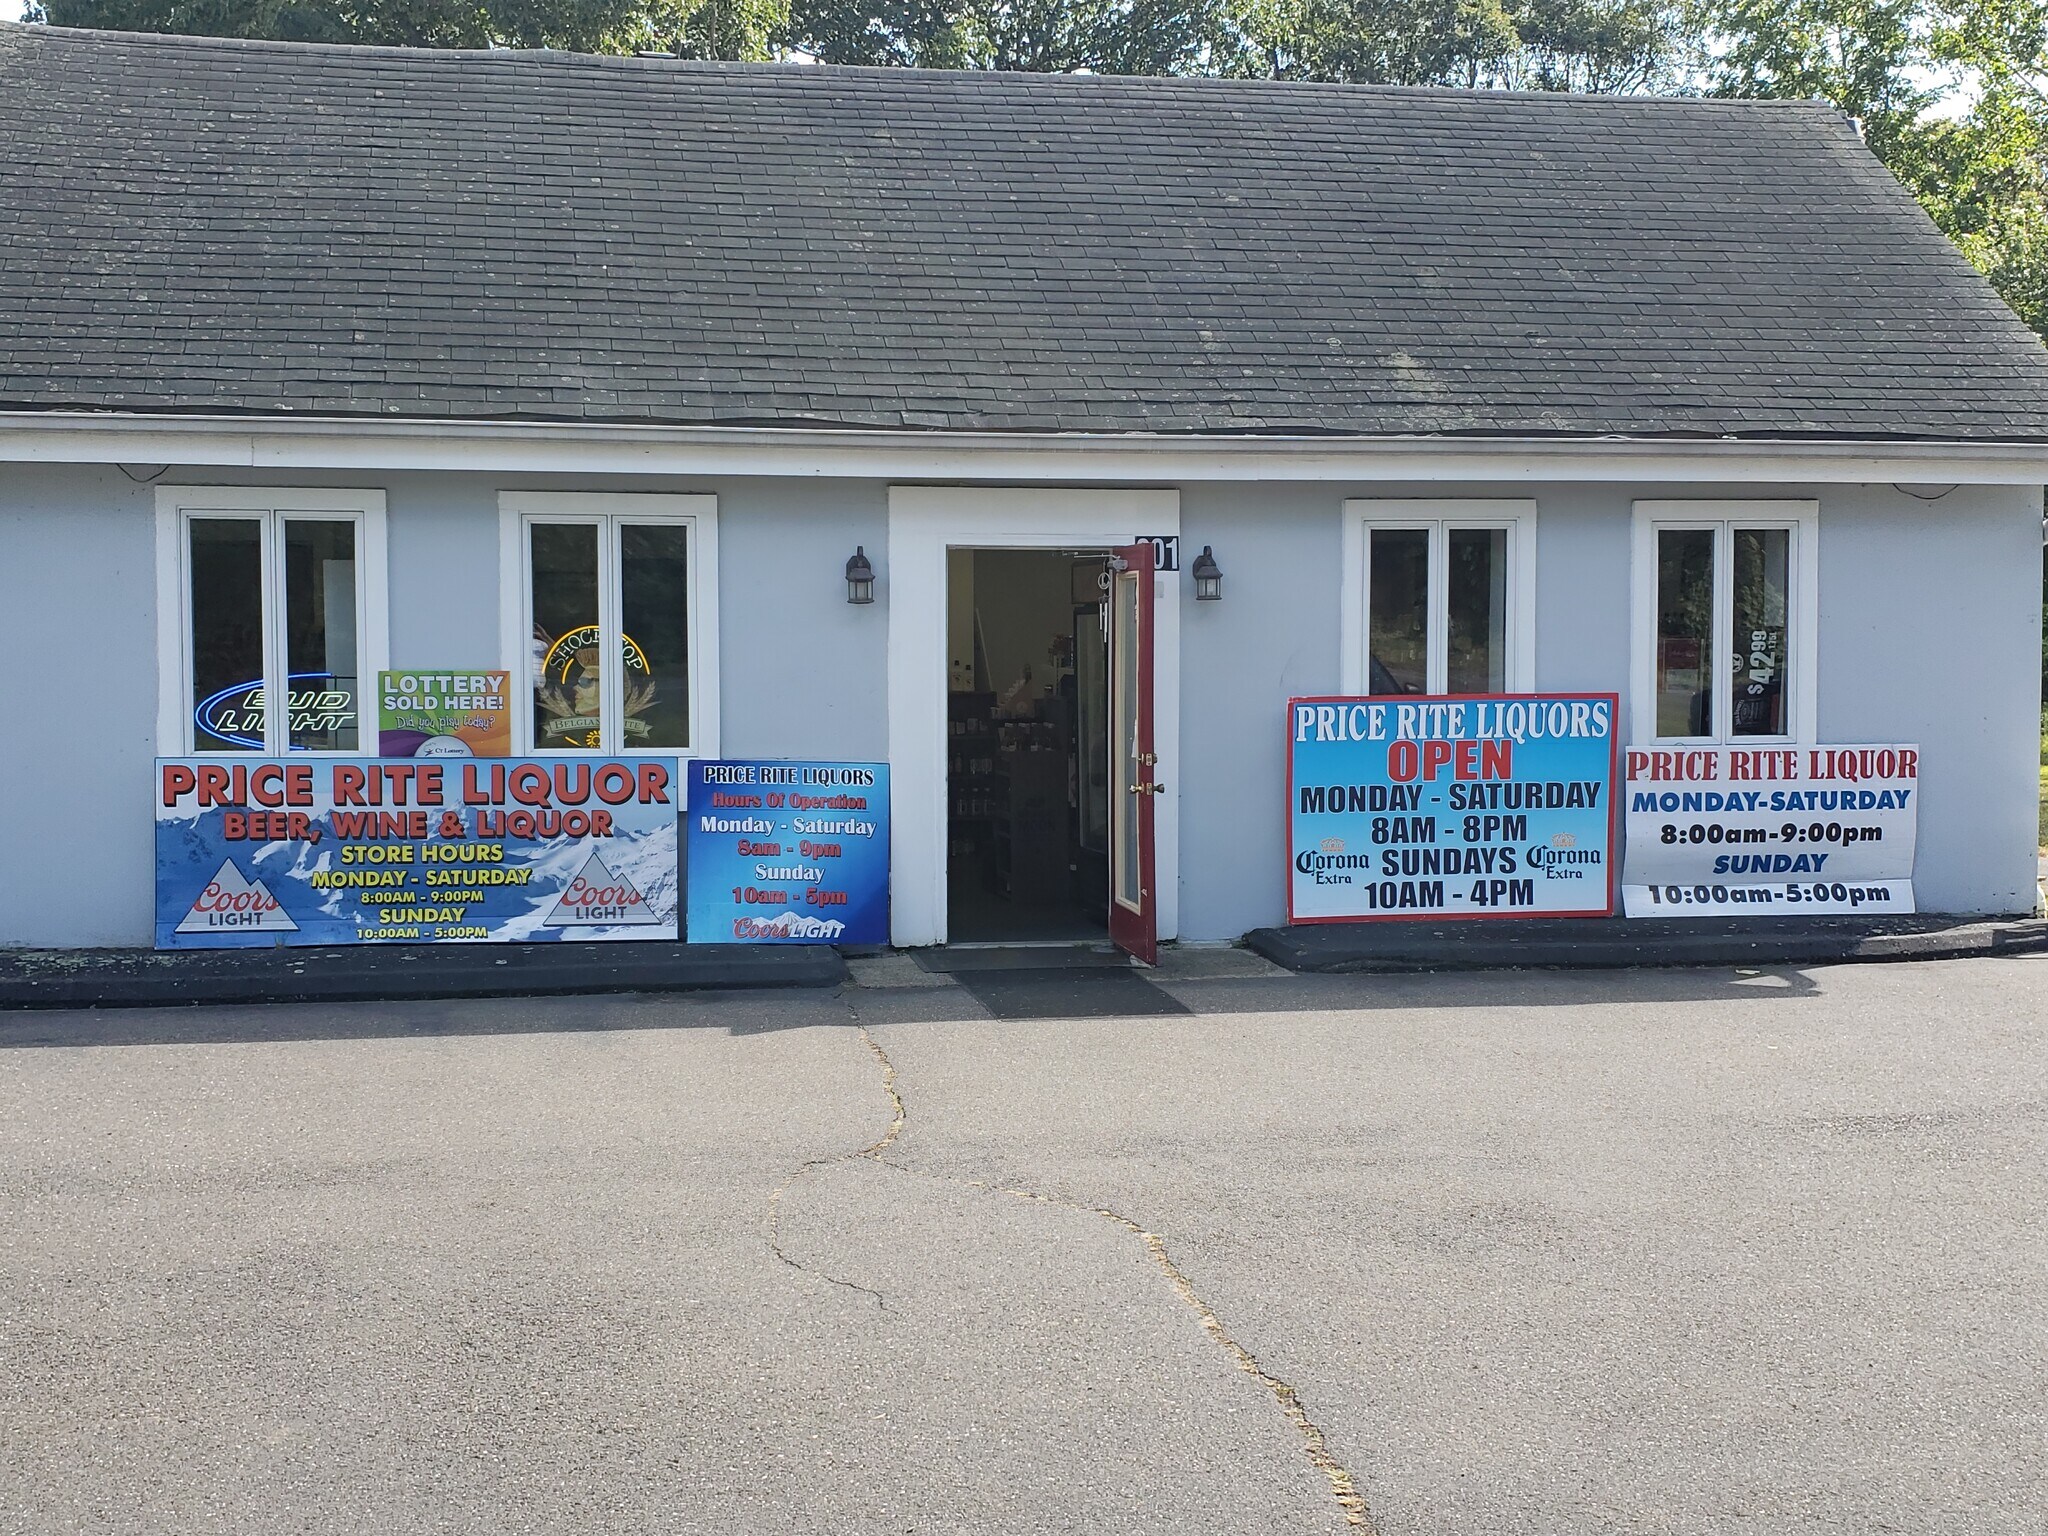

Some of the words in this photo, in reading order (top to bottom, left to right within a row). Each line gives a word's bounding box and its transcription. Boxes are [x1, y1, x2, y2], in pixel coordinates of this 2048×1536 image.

[1137, 538, 1178, 569] 01
[384, 675, 504, 693] LOTTERY
[383, 696, 438, 710] SOLD
[444, 696, 504, 710] HERE!
[396, 715, 415, 729] Did
[418, 718, 435, 729] you
[463, 715, 496, 731] today?
[1296, 704, 1386, 742] PRICE
[1397, 703, 1466, 740] RITE
[1476, 702, 1609, 744] LIQUORS
[1387, 739, 1513, 782] OPEN
[1627, 751, 1718, 781] PRICE
[1729, 751, 1798, 780] RITE
[1809, 750, 1918, 782] LIQUOR
[163, 764, 314, 807] PRICE
[333, 764, 443, 806] RITE
[462, 763, 671, 809] LIQUOR
[704, 766, 756, 784] PRICE
[760, 766, 798, 784] RITE
[802, 768, 874, 787] LIQUORS
[712, 792, 761, 807] Hours
[766, 792, 785, 807] Of
[789, 794, 867, 811] Operation
[1300, 784, 1423, 814] MONDAY
[1449, 781, 1601, 811] SATURDAY
[1632, 789, 1911, 813] MONDAY-SATURDAY
[224, 811, 322, 844] BEER,
[331, 810, 427, 840] WINE
[438, 811, 467, 839] &
[476, 809, 614, 841] LIQUOR
[701, 816, 775, 836] Monday
[793, 818, 877, 839] Saturday
[1371, 816, 1436, 845] 8AM
[1462, 814, 1527, 842] 8PM
[1660, 822, 1883, 847] 8:00am-9:00pm
[341, 845, 414, 863] STORE
[421, 844, 504, 862] HOURS
[737, 839, 780, 856] 8am
[799, 840, 842, 860] 9pm
[1526, 845, 1601, 871] Corona
[755, 863, 825, 883] Sunday
[1296, 849, 1370, 876] Corona
[1382, 847, 1517, 877] SUNDAYS
[1546, 866, 1583, 880] Extra
[1713, 853, 1829, 874] SUNDAY
[311, 870, 408, 888] MONDAY
[425, 868, 532, 887] SATURDAY
[1316, 871, 1352, 885] Extra
[193, 881, 279, 912] Coors
[361, 892, 416, 904] 8:00AM
[431, 891, 484, 903] 9:00PM
[561, 876, 643, 906] Coors
[732, 887, 787, 904] 10am
[806, 888, 847, 908] 5pm
[1364, 880, 1444, 909] 10AM
[1470, 879, 1534, 907] 4PM
[1649, 883, 1891, 906] 10:00am-5:00pm
[208, 913, 264, 926] LIGHT
[379, 907, 465, 924] SUNDAY
[575, 906, 627, 920] LIGHT
[356, 928, 420, 939] 10:00AM
[434, 927, 488, 939] 5:00PM
